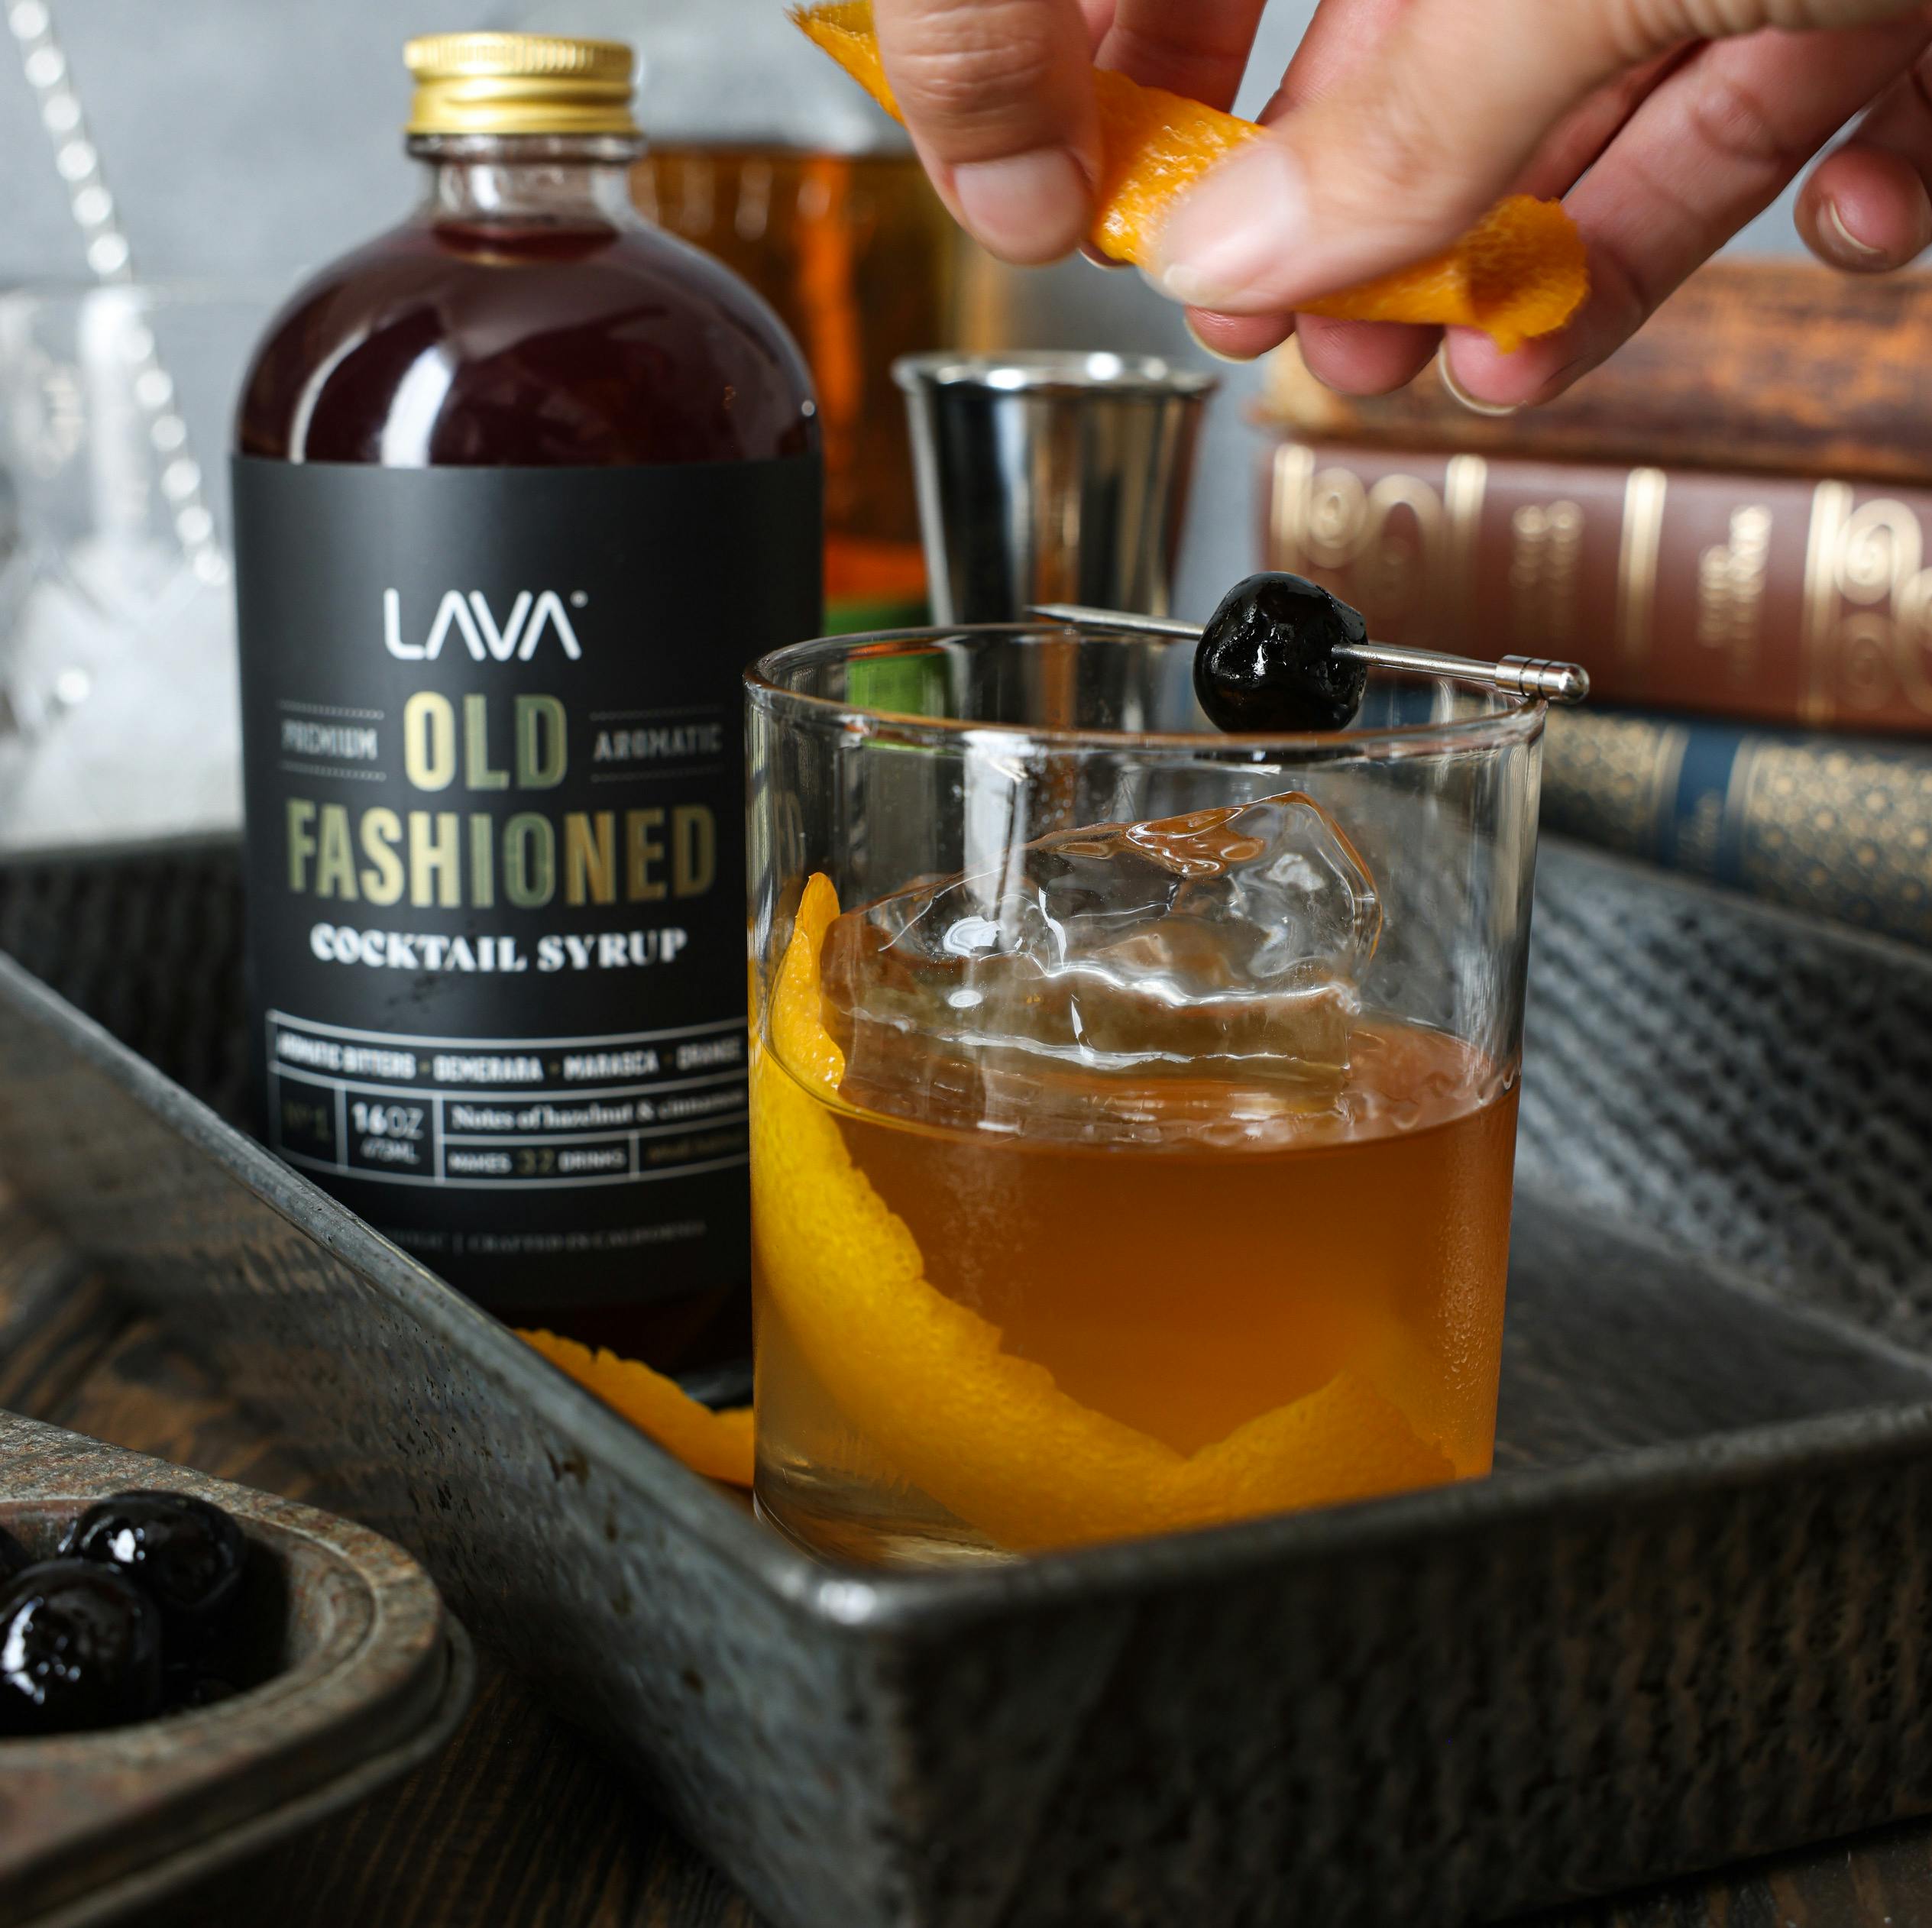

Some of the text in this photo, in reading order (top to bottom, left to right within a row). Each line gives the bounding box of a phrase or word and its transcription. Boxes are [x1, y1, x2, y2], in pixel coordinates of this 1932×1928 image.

[383, 588, 582, 662] LAVA
[280, 718, 379, 761] PREMIUM
[403, 691, 568, 791] OLD
[594, 724, 723, 761] AROMATIC
[286, 797, 717, 909] FASHIONED
[309, 922, 688, 972] COCKTAIL SYRUP
[343, 1045, 416, 1079] BITTERS
[432, 1054, 545, 1083] DEMERARA
[562, 1048, 659, 1081] MARASCA
[451, 1103, 513, 1131] Notes
[516, 1103, 542, 1130] of
[543, 1101, 633, 1129] hazelnut
[636, 1098, 657, 1123] &
[447, 1151, 513, 1175] MAKES
[558, 1148, 627, 1173] DRINKS
